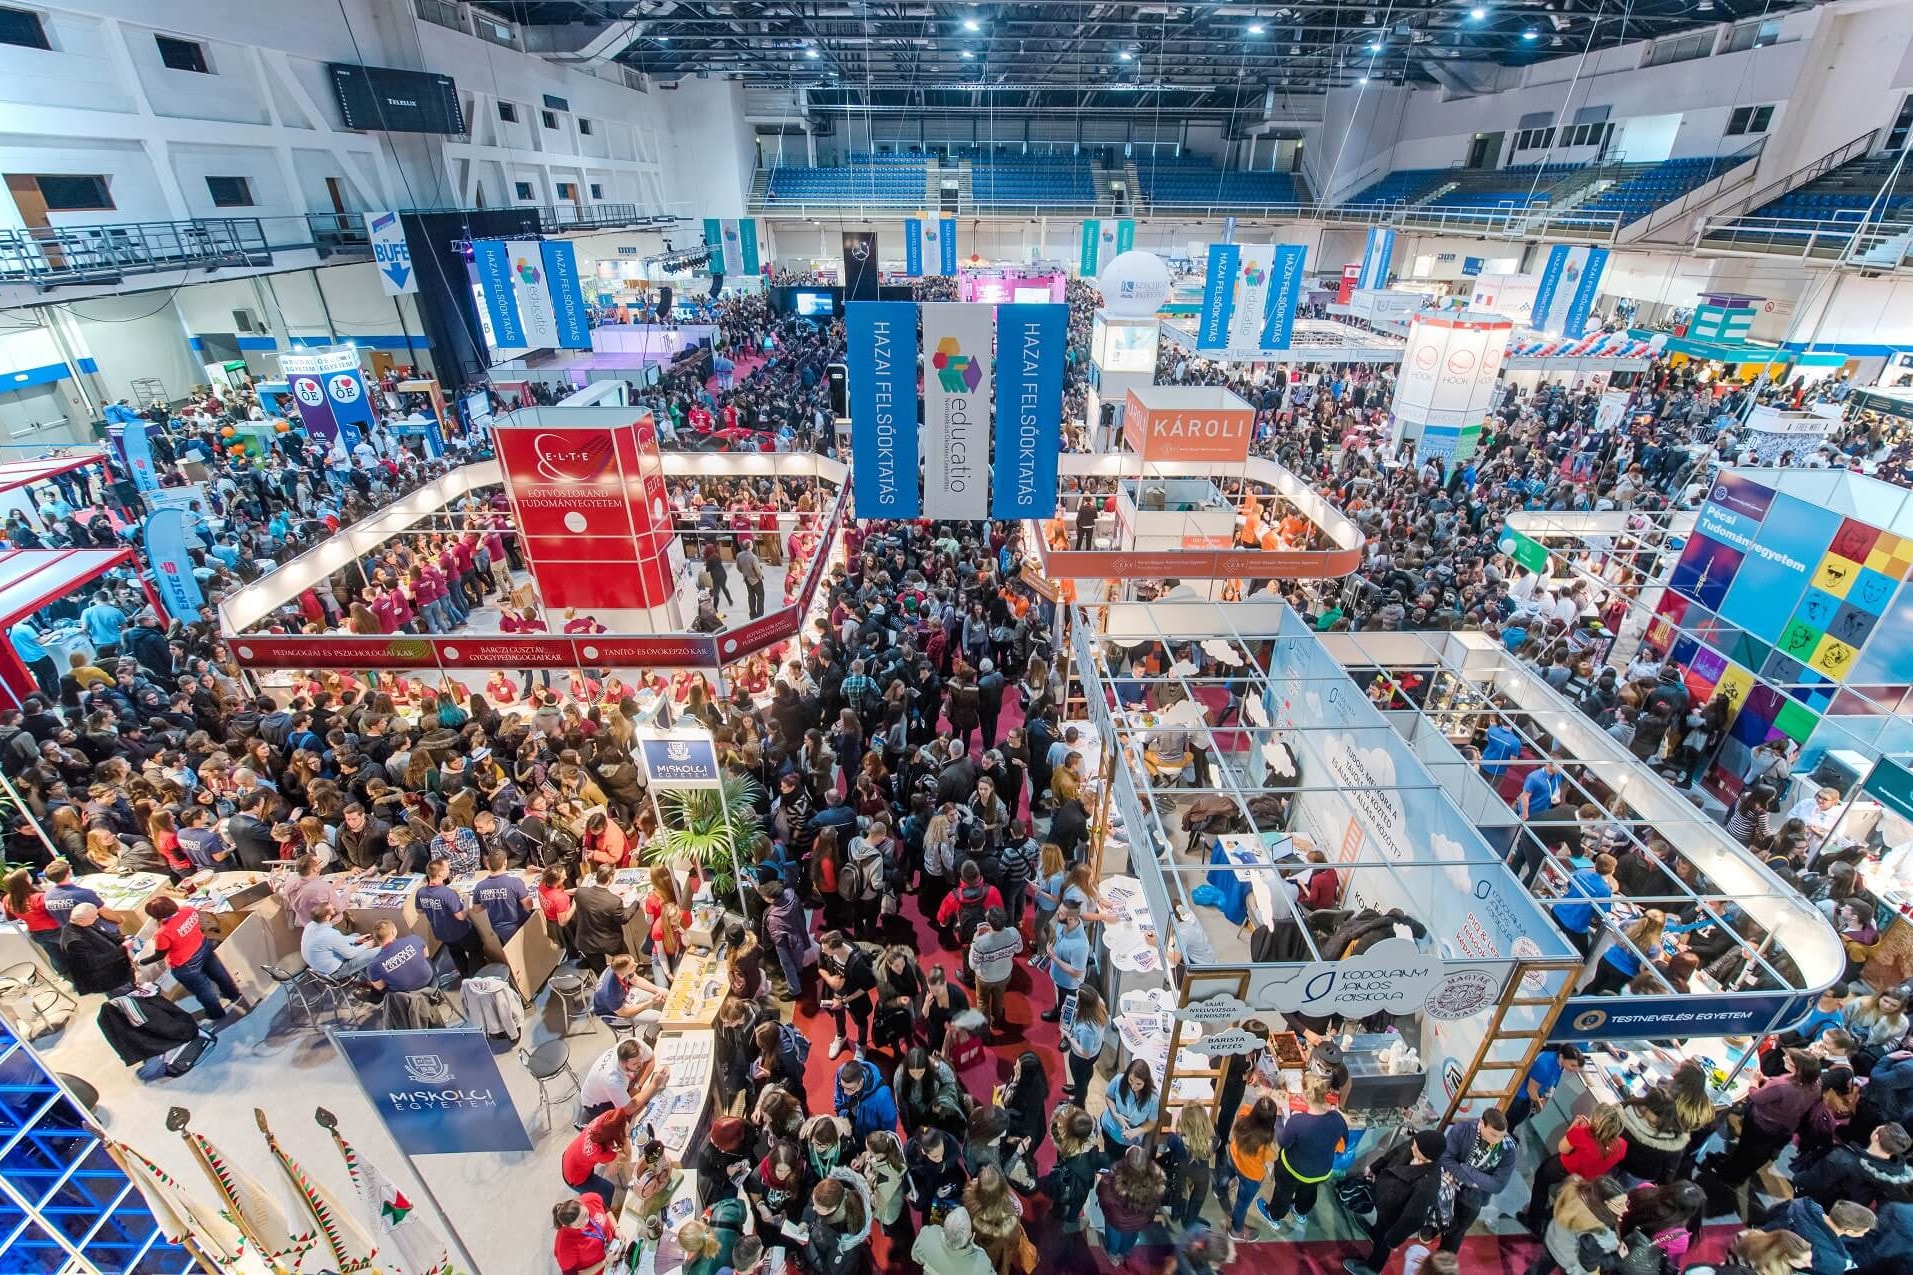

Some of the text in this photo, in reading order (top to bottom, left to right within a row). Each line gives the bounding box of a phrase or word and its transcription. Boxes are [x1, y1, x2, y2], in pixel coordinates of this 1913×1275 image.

[374, 238, 411, 263] BÜFÉ
[486, 250, 515, 341] HAZAI FELSŐOKTATÁS
[555, 250, 580, 341] HAZAI FELSŐOKTATÁS
[1208, 252, 1228, 343] HAZAI FELSŐOKTATÁS
[1272, 253, 1295, 343] HAZAI FELSŐOKTATÁS
[529, 286, 547, 335] educatio
[873, 322, 898, 505] HAZAI FELSŐOKTATÁS
[1017, 323, 1041, 506] HAZAI FELSŐOKTATÁS
[1127, 399, 1147, 433] KÁROLI
[1154, 415, 1244, 438] KÁROLI
[951, 398, 972, 493] educatio
[521, 499, 623, 509] TUDOMÁNYEGYETEM
[528, 487, 609, 498] EÖTVÖS LORÁND
[1706, 505, 1738, 526] Pécsi
[1702, 518, 1806, 573] Tudományegyetem
[167, 574, 190, 611] ERSTE
[656, 765, 708, 774] MISKOLCI
[1347, 745, 1365, 776] TUDOD,
[1370, 798, 1392, 829] KÖZTED
[1375, 821, 1402, 858] KÖZÖTT?
[479, 887, 508, 896] MISKOLCI
[1467, 913, 1481, 933] PIQ
[381, 943, 414, 969] MISKOLCI
[1447, 974, 1491, 985] MAGYAR
[1611, 1010, 1753, 1024] TESTNEVELÉSI EGYETEM
[1207, 1036, 1246, 1044] BARISTA
[388, 1088, 493, 1103] MISKOLCI
[395, 1100, 497, 1111] EGYETEM
